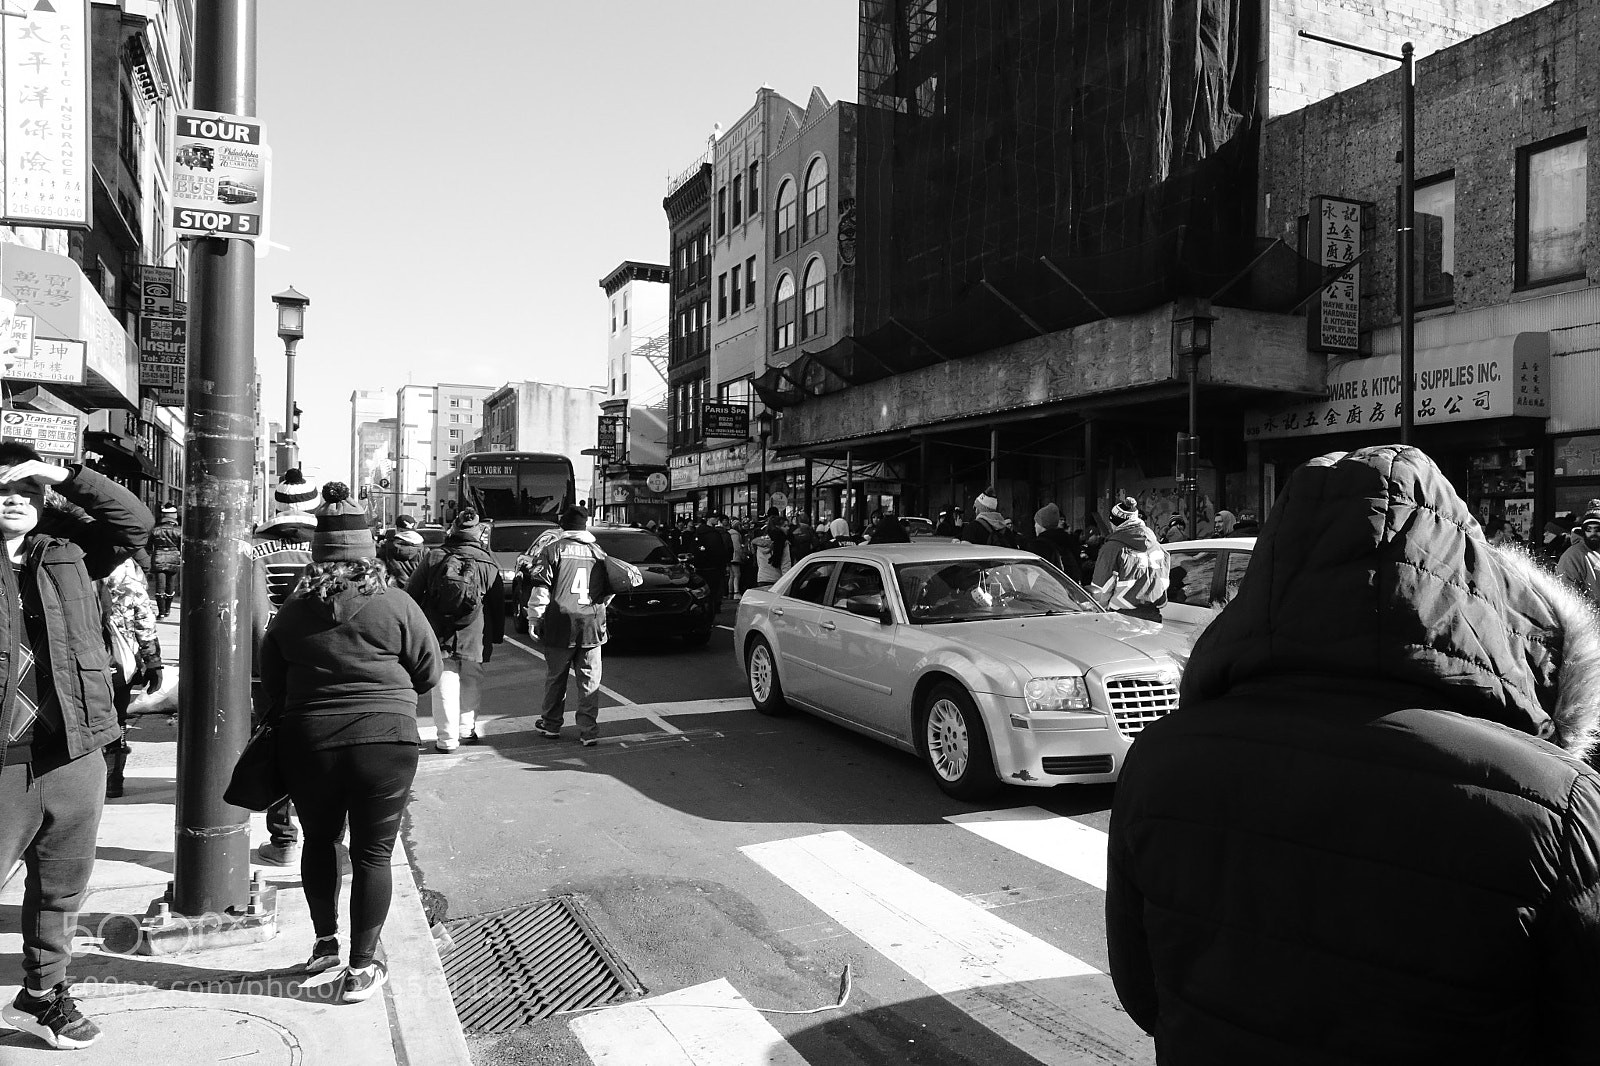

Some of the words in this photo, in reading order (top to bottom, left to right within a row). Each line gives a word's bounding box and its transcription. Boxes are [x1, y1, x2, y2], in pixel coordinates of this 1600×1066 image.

[60, 24, 71, 87] PACIFIC
[60, 96, 73, 176] INSURANCE
[187, 119, 250, 142] TOUR
[174, 174, 194, 182] THE
[177, 181, 214, 195] BUS
[174, 193, 214, 201] COMPANY
[12, 203, 83, 218] 215-625-0340
[180, 210, 231, 230] STOP
[238, 215, 250, 231] 5
[1326, 285, 1354, 301] 公司
[1322, 301, 1344, 310] WAYNE
[1346, 303, 1358, 312] KEE
[1322, 309, 1357, 319] HARDWARE
[1330, 318, 1357, 327] KITCHEN
[1322, 325, 1345, 334] SUPPLIES
[160, 355, 186, 364] 267-3
[1361, 379, 1368, 398] &
[1421, 365, 1474, 391] SUPPLIES
[1477, 361, 1501, 384] INC.
[25, 413, 78, 426] Trans-Fast
[468, 466, 482, 474] NEW
[484, 466, 502, 474] YORK
[504, 466, 513, 474] NY
[570, 567, 591, 605] 4
